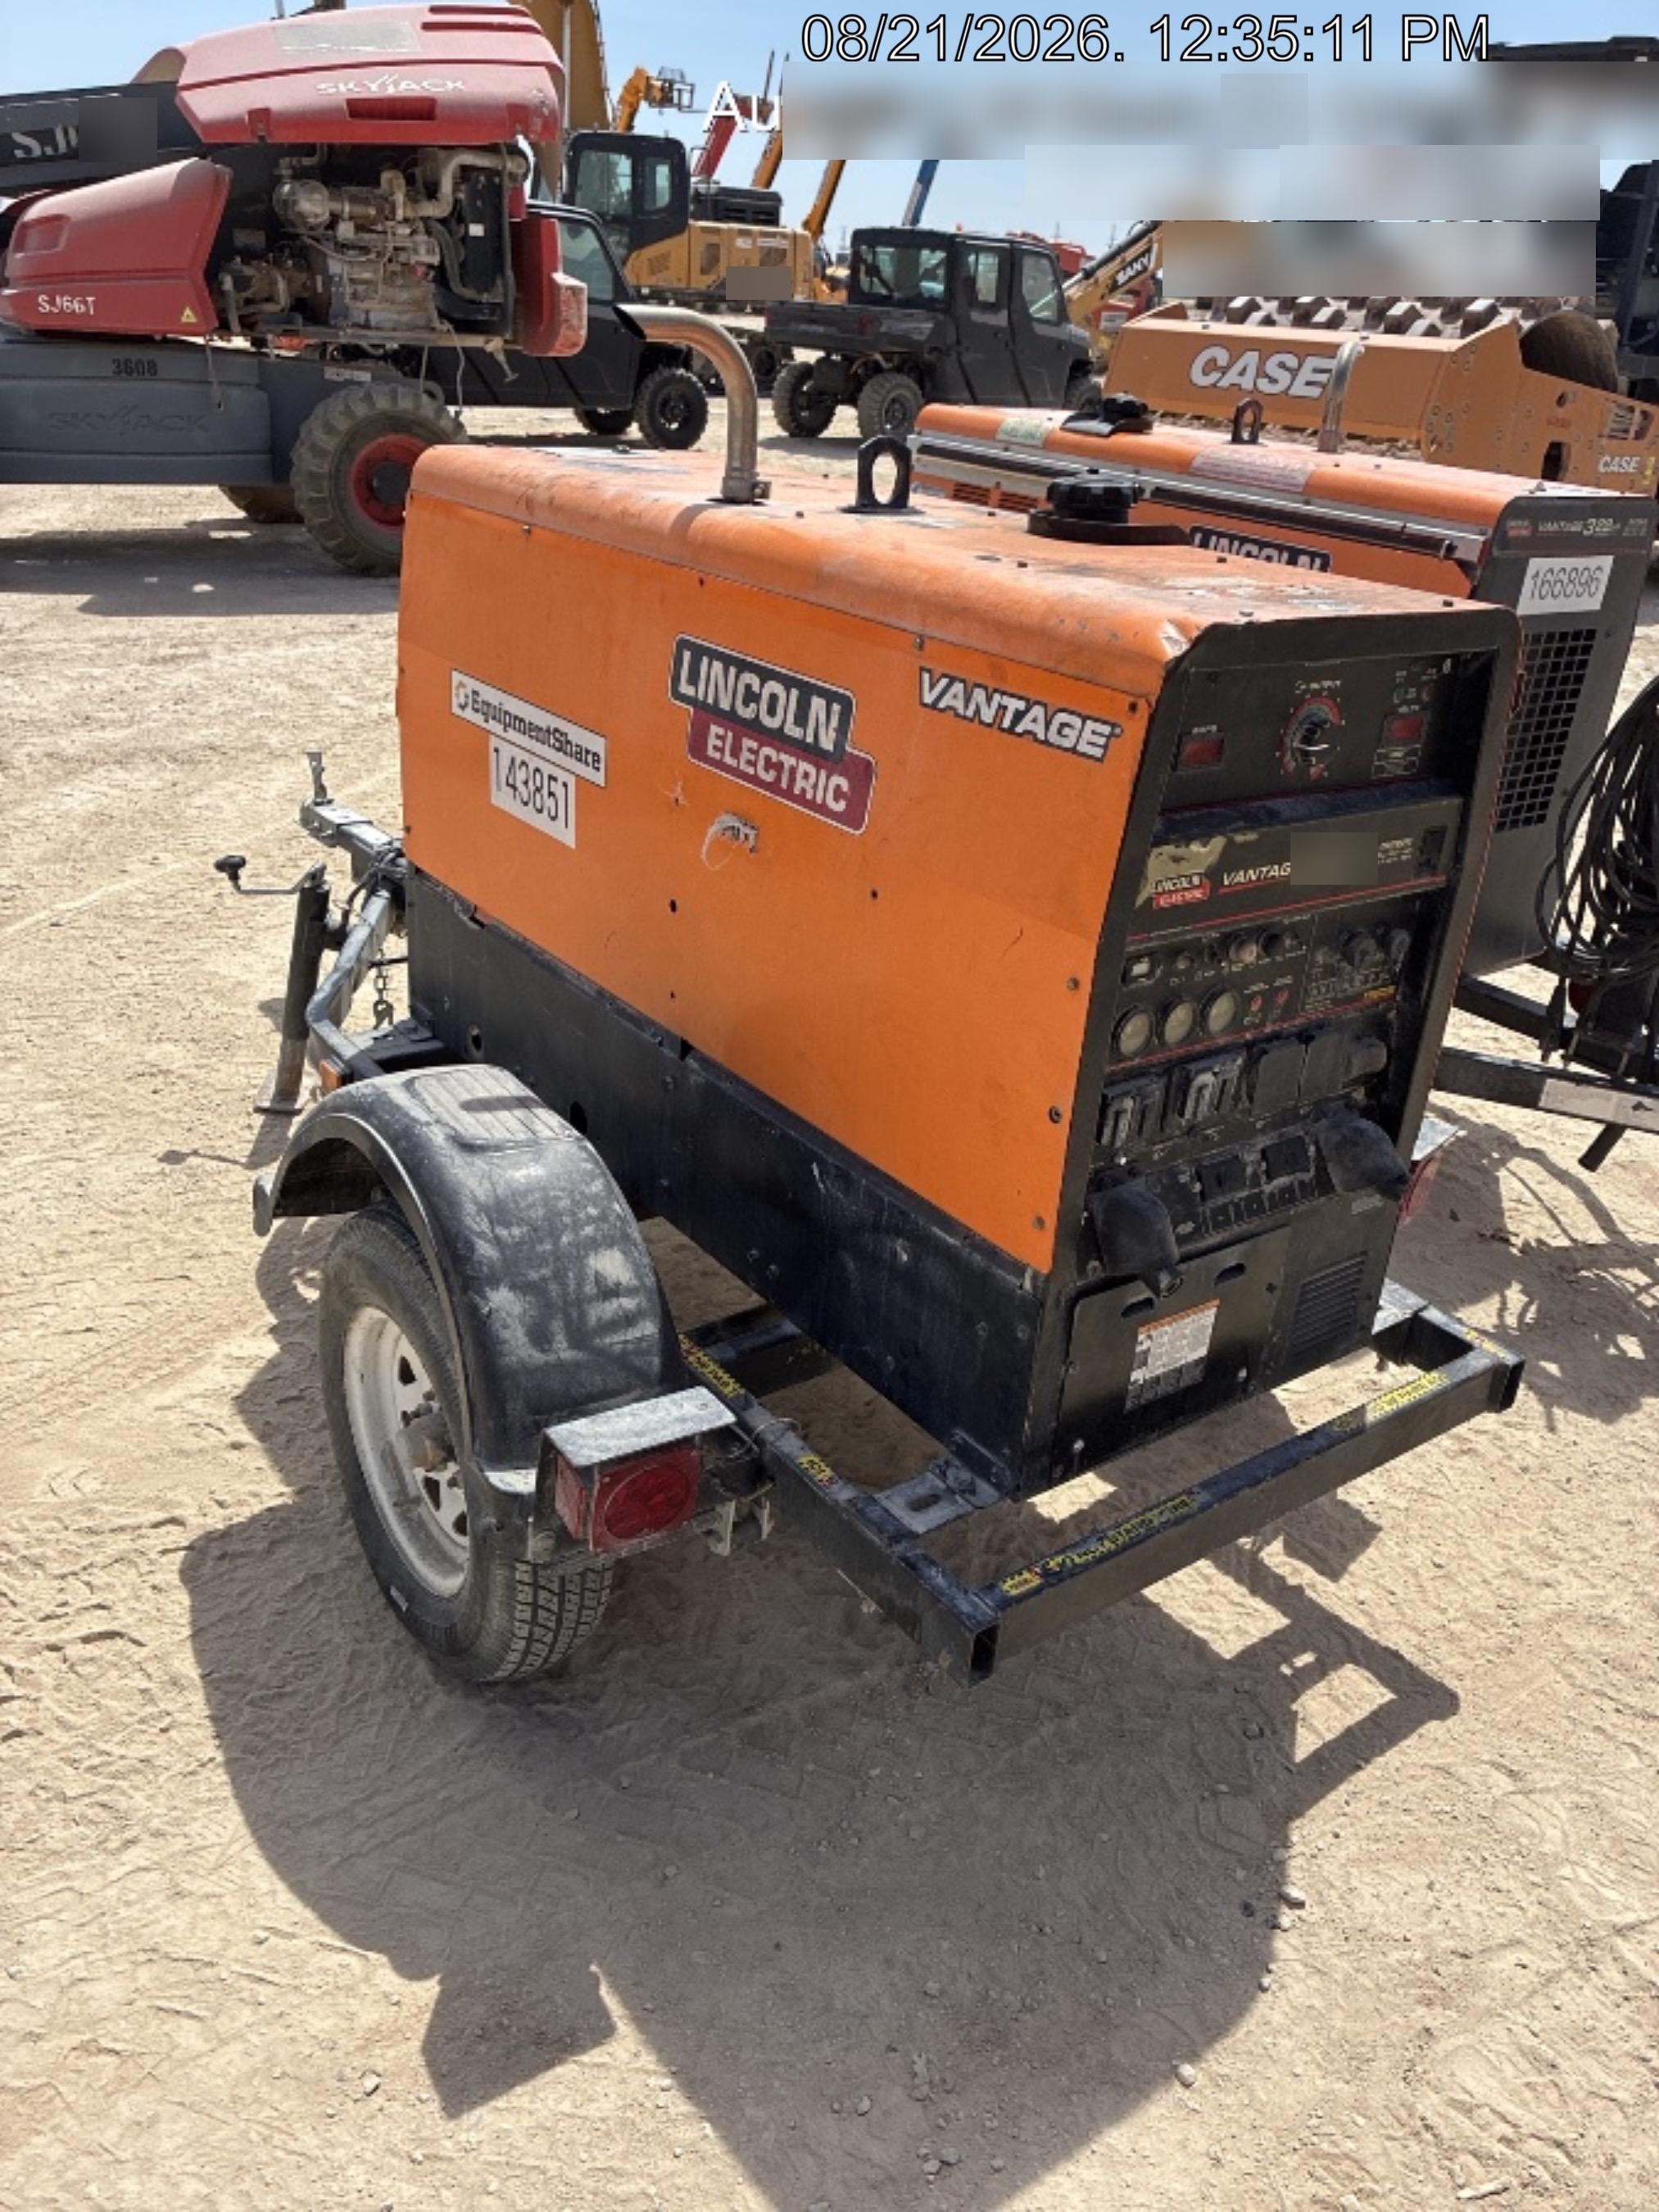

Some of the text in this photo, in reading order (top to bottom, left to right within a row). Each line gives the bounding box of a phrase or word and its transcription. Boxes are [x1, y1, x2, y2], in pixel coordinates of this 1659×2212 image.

[315, 74, 466, 95] SKYJACK
[38, 294, 96, 315] SJ66T
[111, 357, 158, 377] 3608
[1190, 345, 1336, 399] CASE
[1598, 456, 1640, 474] CASE
[1530, 565, 1603, 601] 166896
[678, 650, 841, 753] LINCOLN
[921, 670, 1113, 759] VANTAGE
[470, 689, 601, 773] EquipmentShare
[493, 747, 569, 829] 143851
[706, 724, 850, 821] ELECTRIC
[1223, 863, 1291, 886] VANTAG
